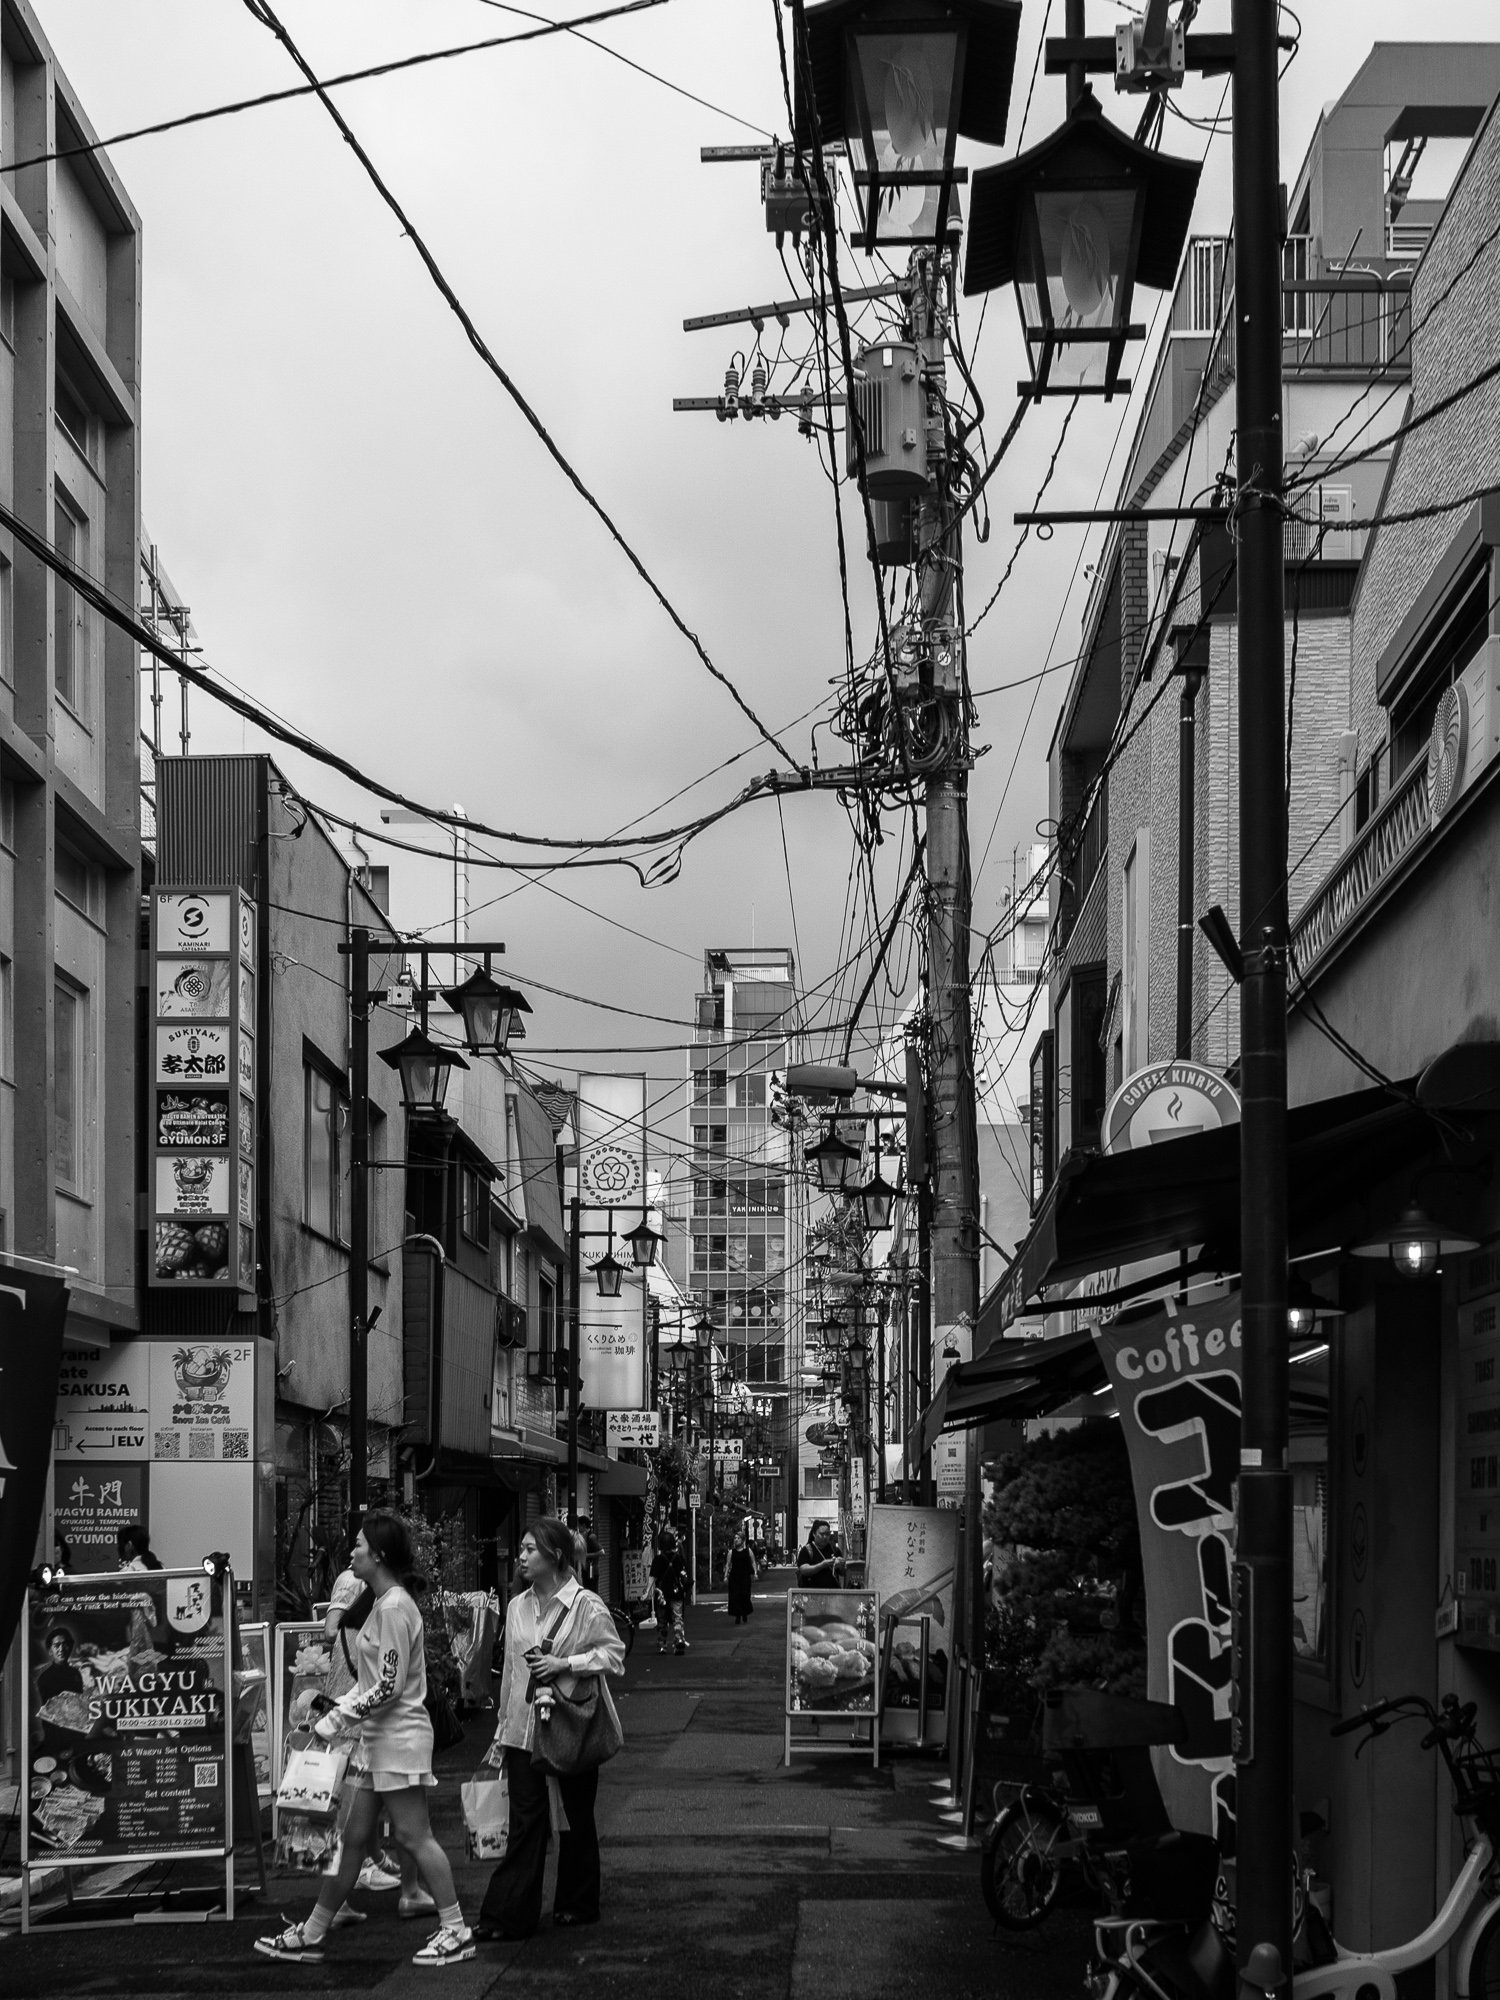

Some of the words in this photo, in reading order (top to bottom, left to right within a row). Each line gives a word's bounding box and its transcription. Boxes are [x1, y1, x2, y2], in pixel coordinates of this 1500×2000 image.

[160, 895, 173, 903] 6F
[168, 1028, 220, 1042] SUKIYAKI
[161, 1053, 226, 1074] 孝太郎
[1122, 1070, 1168, 1106] COFFEE
[1172, 1069, 1223, 1098] KINRYU
[159, 1135, 211, 1145] GYUMON
[212, 1133, 227, 1145] 3F
[218, 1157, 229, 1165] 2F
[1473, 1306, 1496, 1336] COFFEE
[587, 1334, 626, 1344] くくりひめ
[60, 1348, 100, 1361] rand
[233, 1349, 251, 1361] 2F
[614, 1345, 636, 1355] 珈琲
[59, 1365, 89, 1379] ate
[1475, 1358, 1495, 1384] TOAST
[56, 1384, 131, 1397] SAKUSA
[172, 1403, 231, 1415] かき氷カフェ
[172, 1415, 195, 1425] Snow
[195, 1415, 209, 1425] Ice
[210, 1415, 231, 1425] Café
[609, 1413, 652, 1423] 大衆酒場
[608, 1424, 657, 1433] やきとり一品料理
[117, 1436, 145, 1447] ELV
[620, 1432, 654, 1446] 一代
[1471, 1457, 1486, 1489] EAT
[1488, 1455, 1498, 1489] IN
[54, 1508, 94, 1517] WAGYU
[96, 1508, 139, 1517] RAMEN
[904, 1521, 918, 1578] ひなと丸
[1470, 1557, 1482, 1591] TO
[1483, 1557, 1497, 1592] GO
[103, 1602, 120, 1610] beef
[95, 1670, 198, 1695] WAGYU
[88, 1693, 218, 1720] SUKIYAKI
[182, 1718, 205, 1726] 22:00
[121, 1749, 133, 1757] A5
[135, 1748, 162, 1757] Wagyu
[165, 1746, 178, 1755] Set
[181, 1744, 212, 1754] Options
[145, 1789, 158, 1799] Set
[160, 1788, 191, 1798] content
